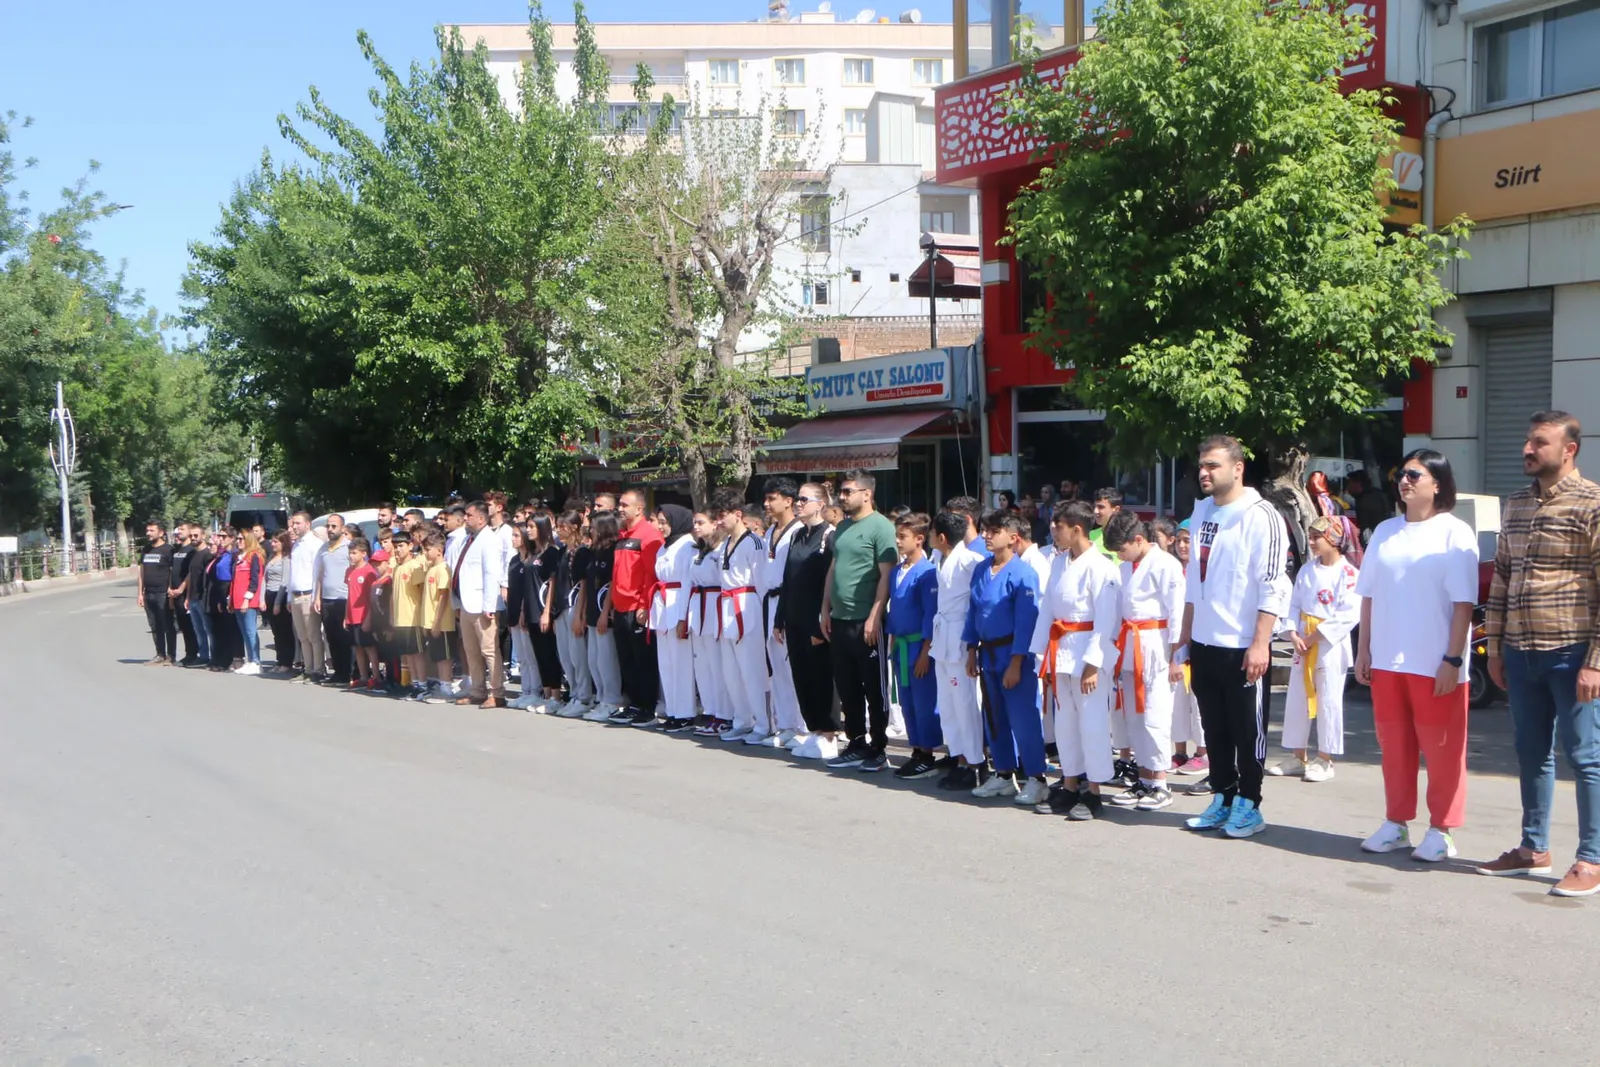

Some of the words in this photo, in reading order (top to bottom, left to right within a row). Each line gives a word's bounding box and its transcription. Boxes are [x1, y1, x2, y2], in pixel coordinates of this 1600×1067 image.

[1494, 164, 1541, 188] Siirt
[811, 373, 855, 399] UMUT
[857, 369, 884, 395] ÇAY
[889, 361, 945, 386] SALONU
